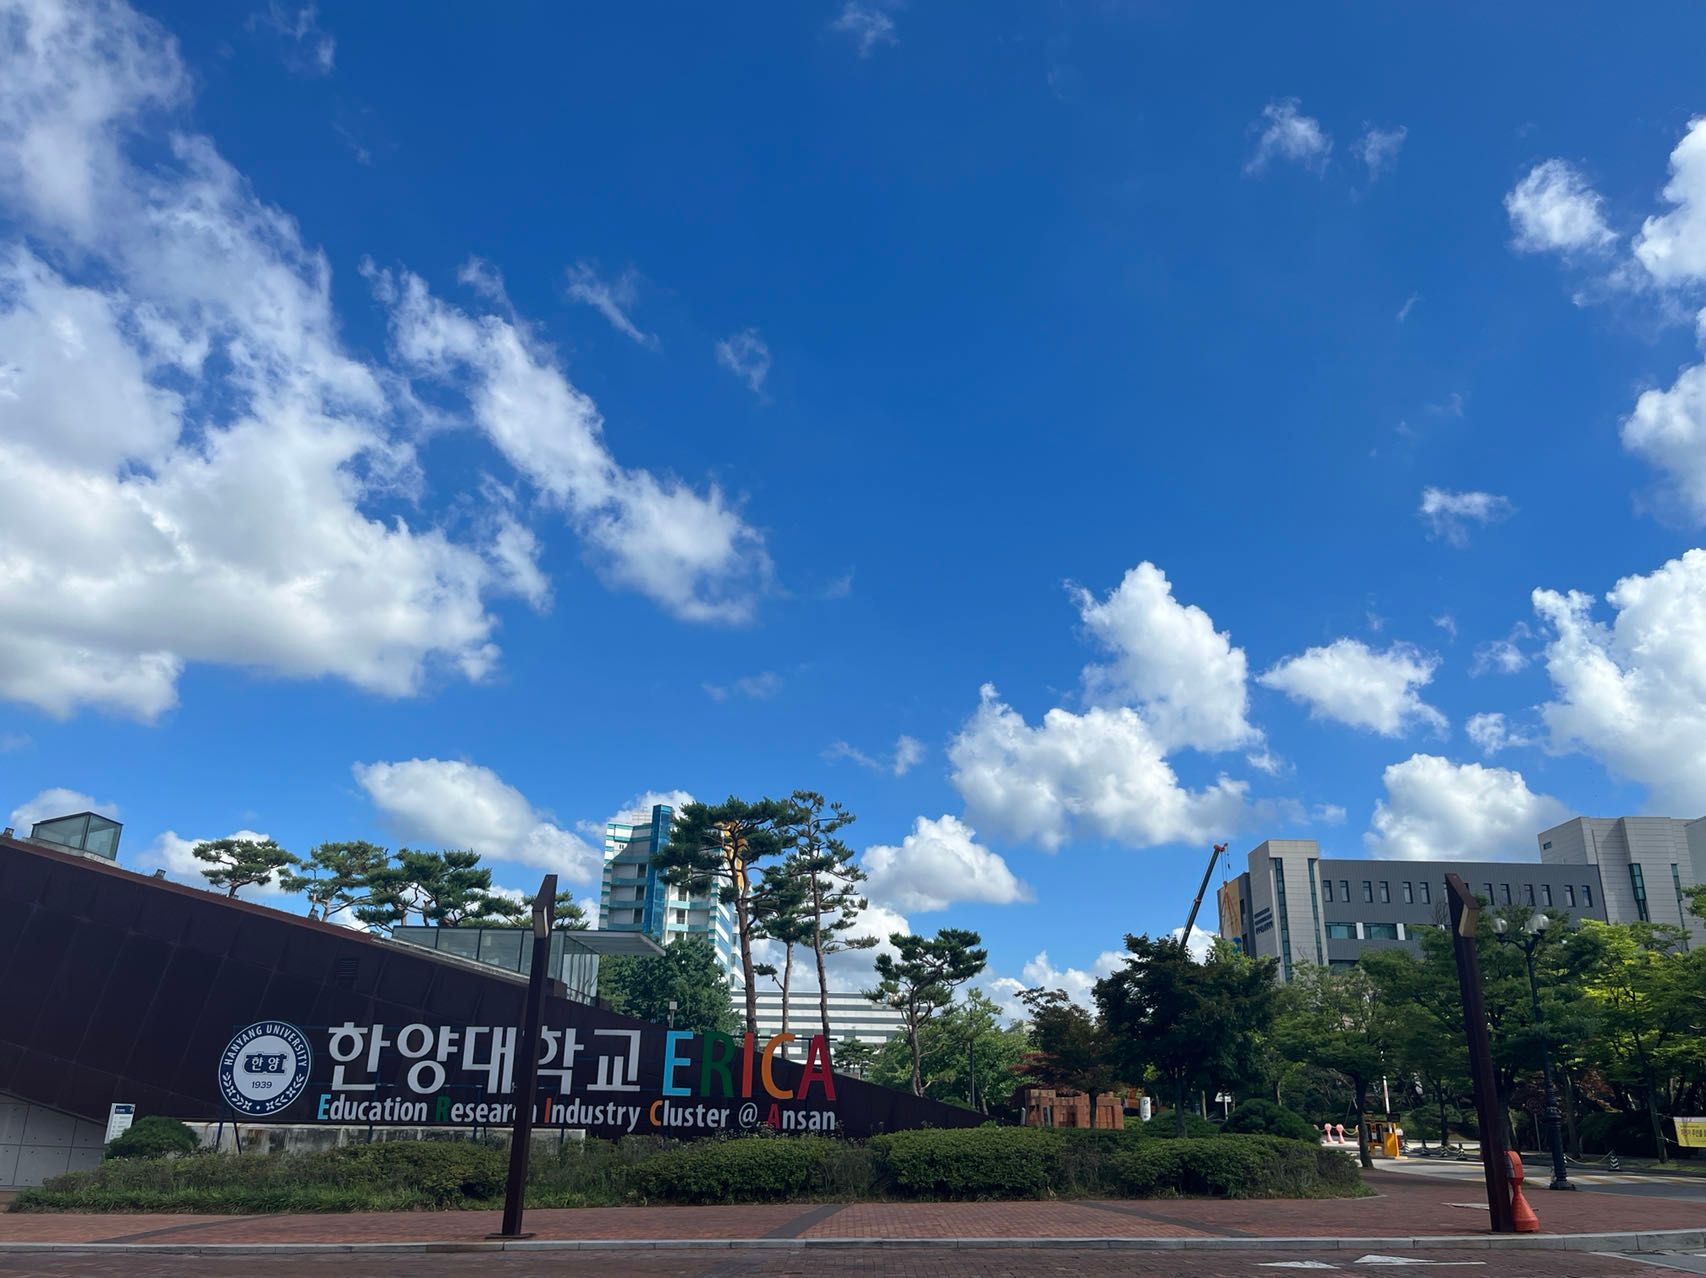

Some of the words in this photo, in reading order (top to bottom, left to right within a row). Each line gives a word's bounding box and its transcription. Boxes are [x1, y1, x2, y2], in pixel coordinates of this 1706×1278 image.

[224, 1026, 262, 1066] HANYANG
[266, 1024, 307, 1067] UNIVERSITY
[328, 1022, 641, 1095] 한양대학교
[662, 1030, 836, 1100] ERICA
[251, 1081, 272, 1089] 1939
[317, 1094, 428, 1121] Education
[544, 1098, 641, 1132] Industry
[650, 1099, 730, 1127] Cluster
[739, 1102, 758, 1129] @
[767, 1103, 836, 1131] Ansan
